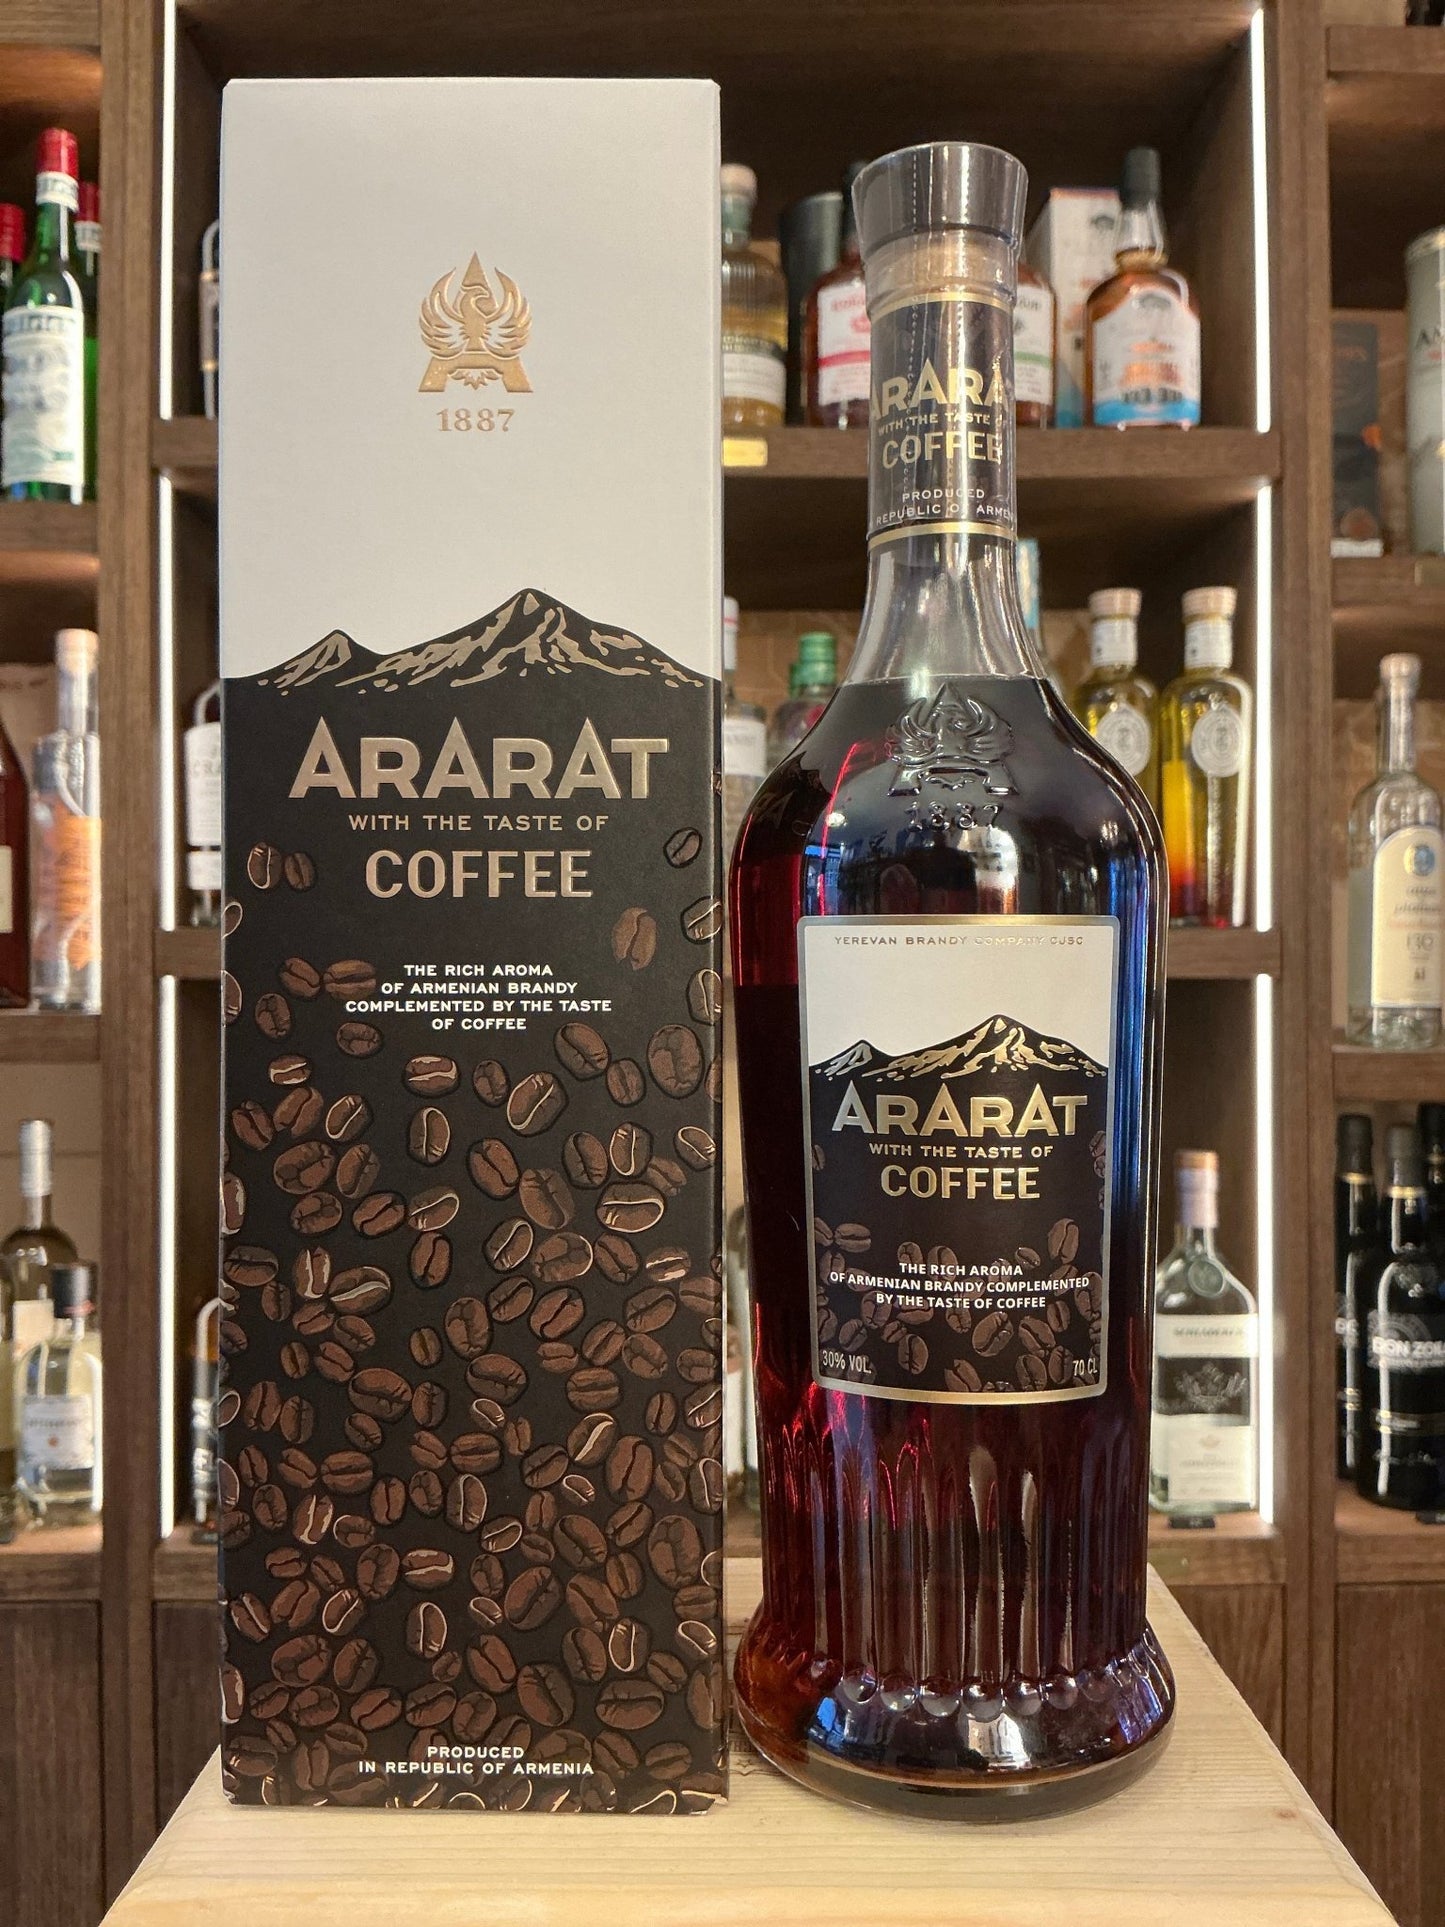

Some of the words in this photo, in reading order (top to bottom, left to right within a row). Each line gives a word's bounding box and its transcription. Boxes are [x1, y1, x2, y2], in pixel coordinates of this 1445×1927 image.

[436, 408, 515, 432] 1887
[878, 419, 904, 436] WITH
[911, 413, 938, 426] THE
[945, 412, 990, 425] TASTE
[882, 430, 1003, 470] COFFEE
[902, 488, 985, 503] PRODUCED
[876, 504, 941, 526] REPUBLIC
[288, 716, 669, 799] ARARAT
[348, 815, 410, 831] WITH
[423, 815, 471, 831] THE
[484, 815, 562, 831] TASTE
[576, 815, 609, 831] OF
[366, 850, 593, 898] COFFEE
[835, 936, 897, 945] YEREVAN
[906, 936, 967, 945] BRANDY
[975, 936, 1044, 945] COMPANY
[1050, 936, 1083, 945] CJSC
[404, 964, 437, 976] THE
[445, 964, 484, 976] RICH
[493, 964, 553, 976] AROMA
[381, 982, 404, 994] OF
[410, 982, 499, 994] ARMENIAN
[509, 982, 577, 994] BRANDY
[346, 1000, 484, 1012] COMPLEMENTED
[493, 1000, 513, 1012] BY
[520, 1000, 552, 1012] THE
[559, 1000, 611, 1012] TASTE
[432, 1018, 454, 1030] OF
[461, 1018, 526, 1030] COFFEE
[832, 1080, 1088, 1137] ARARAT
[869, 1143, 911, 1156] WITH
[921, 1146, 956, 1157] THE
[965, 1146, 1022, 1158] TASTE
[1031, 1145, 1053, 1157] OF
[881, 1164, 1040, 1199] COFFEE
[899, 1263, 926, 1275] THE
[930, 1264, 965, 1276] RICH
[970, 1265, 1023, 1276] AROMA
[830, 1271, 845, 1283] OF
[848, 1275, 921, 1290] ARMENIAN
[924, 1281, 983, 1293] BRANDY
[987, 1277, 1089, 1293] COMPLEMENTED
[876, 1293, 893, 1305] BY
[897, 1295, 923, 1307] THE
[927, 1297, 970, 1309] TASTE
[975, 1297, 993, 1309] OF
[997, 1297, 1045, 1309] COFFEE
[822, 1350, 846, 1370] 30%
[849, 1354, 872, 1374] VOL.
[1072, 1360, 1085, 1376] 70
[1087, 1358, 1098, 1374] CL
[428, 1747, 524, 1758] PRODUCED
[359, 1761, 376, 1773] IN
[386, 1762, 473, 1774] REPUBLIC
[483, 1763, 505, 1774] OF
[513, 1763, 594, 1774] ARMENIA
